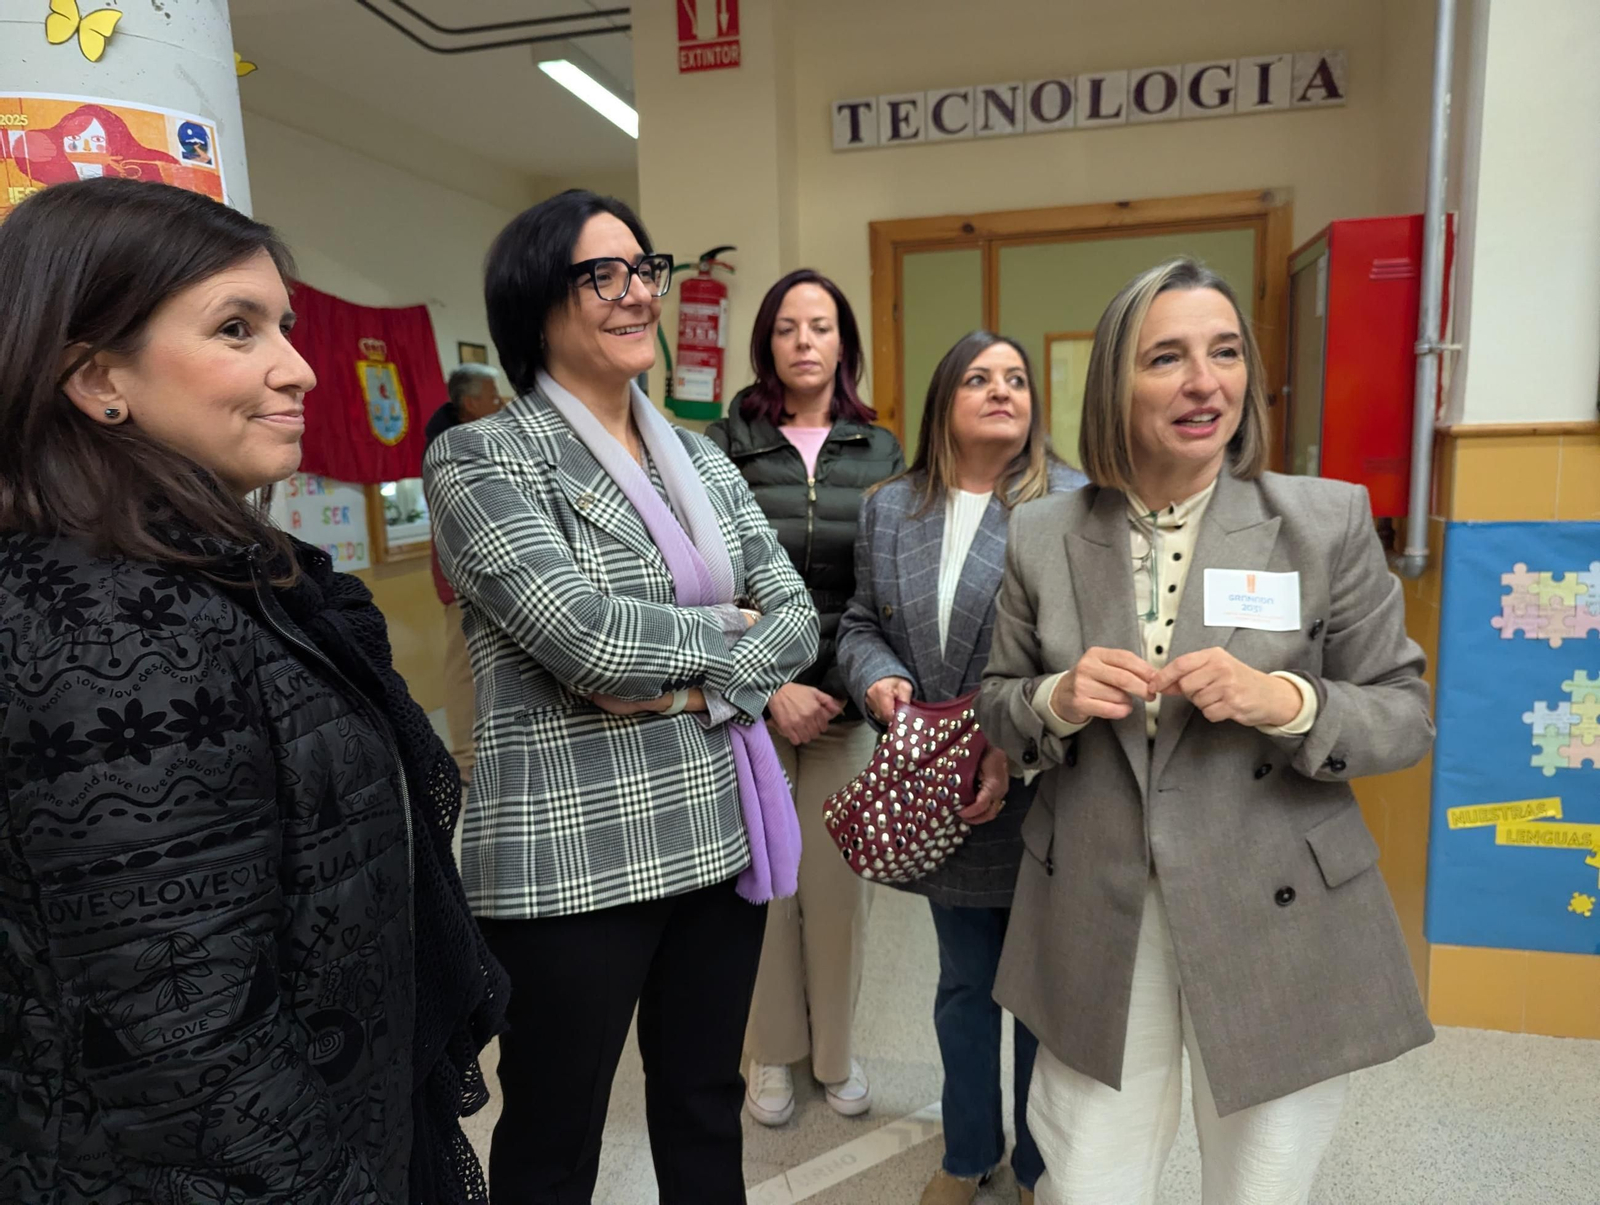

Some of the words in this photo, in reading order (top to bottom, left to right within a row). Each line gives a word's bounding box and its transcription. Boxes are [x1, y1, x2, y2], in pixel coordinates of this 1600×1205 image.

[681, 44, 739, 69] EXTINTOR
[836, 56, 1344, 145] TECNOLOGÍA
[322, 506, 350, 526] SER
[39, 680, 72, 713] world
[77, 676, 106, 695] love
[109, 684, 141, 698] love
[67, 774, 101, 808] world
[104, 771, 133, 791] love
[137, 779, 168, 795] love
[1506, 828, 1593, 847] LENGUAS
[47, 893, 108, 924] OVE
[137, 871, 229, 908] LOVE
[162, 1019, 209, 1043] LOVE
